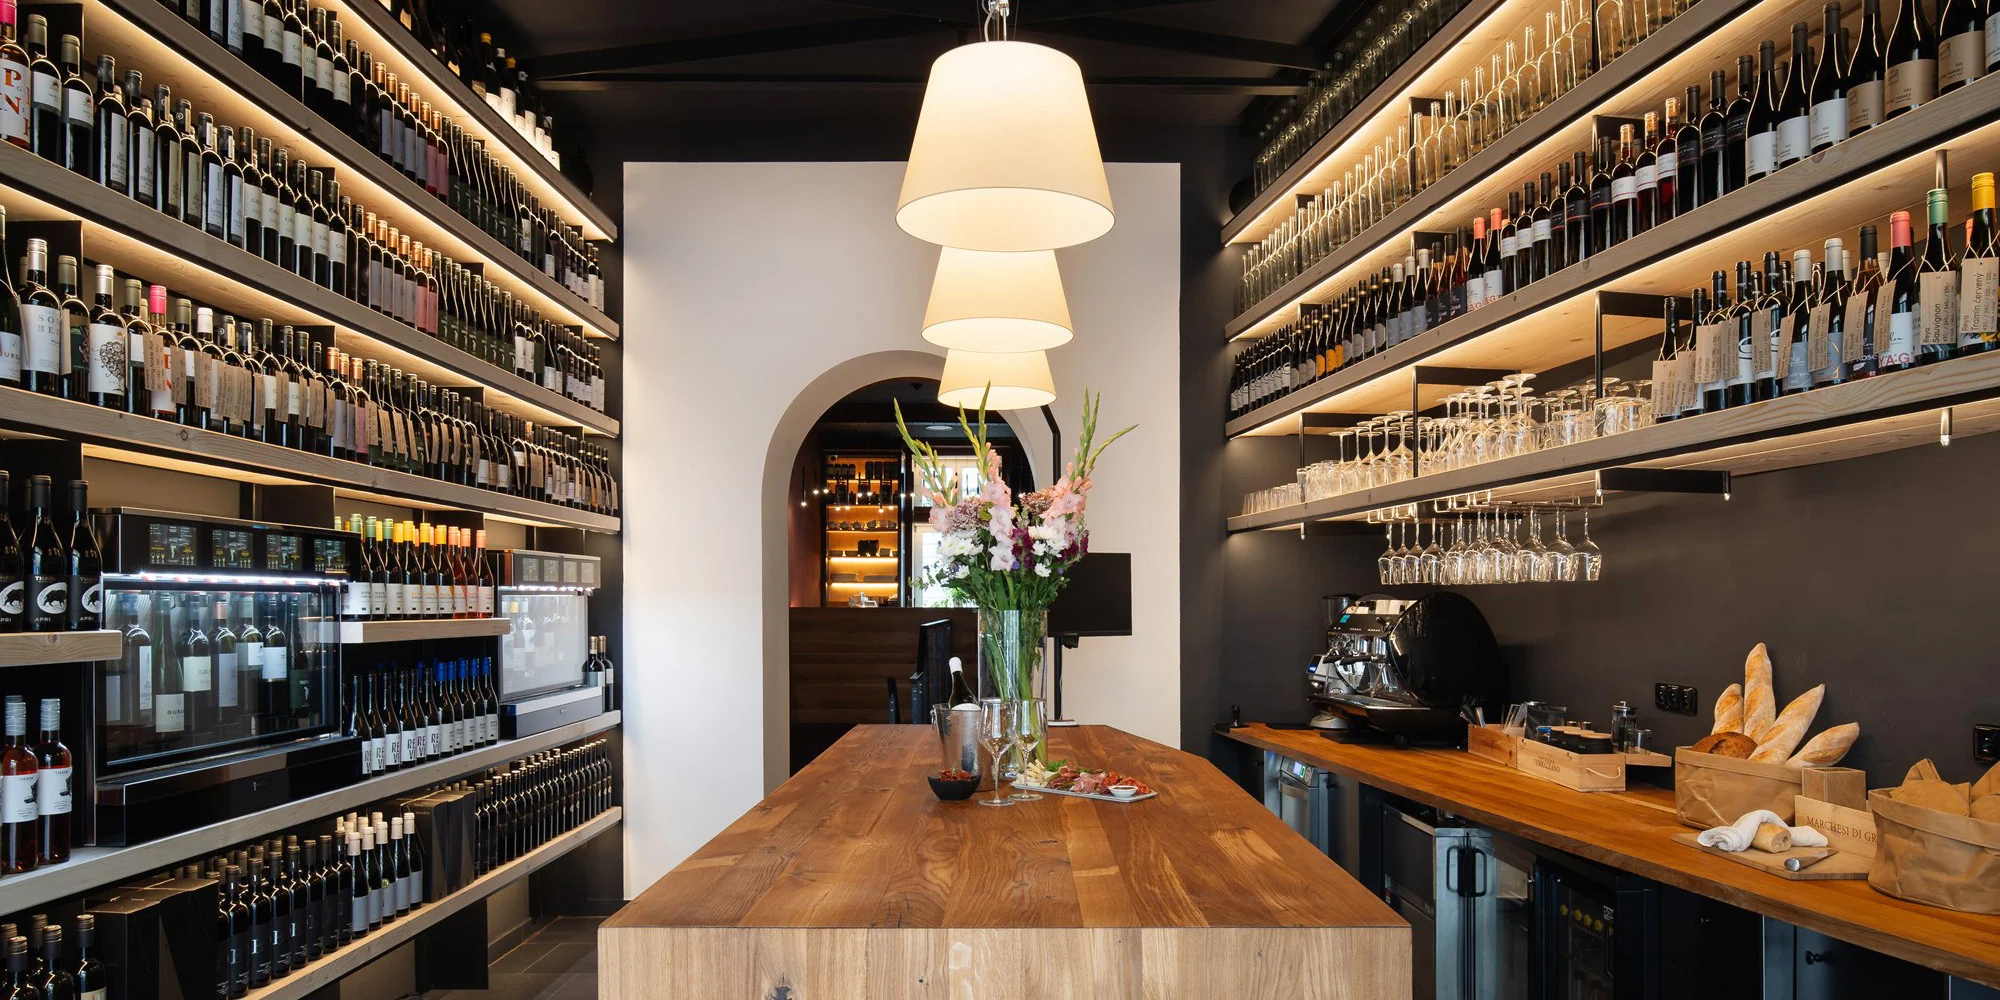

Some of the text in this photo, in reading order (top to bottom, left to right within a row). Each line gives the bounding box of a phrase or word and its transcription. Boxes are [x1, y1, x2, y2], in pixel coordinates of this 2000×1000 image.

[1971, 273, 1985, 331] Tramín červený
[1932, 303, 1942, 343] Sauvignon
[1961, 316, 1971, 332] Reya
[1923, 327, 1932, 343] Reya
[1806, 816, 1849, 835] MARCHESI
[1852, 828, 1862, 839] DI
